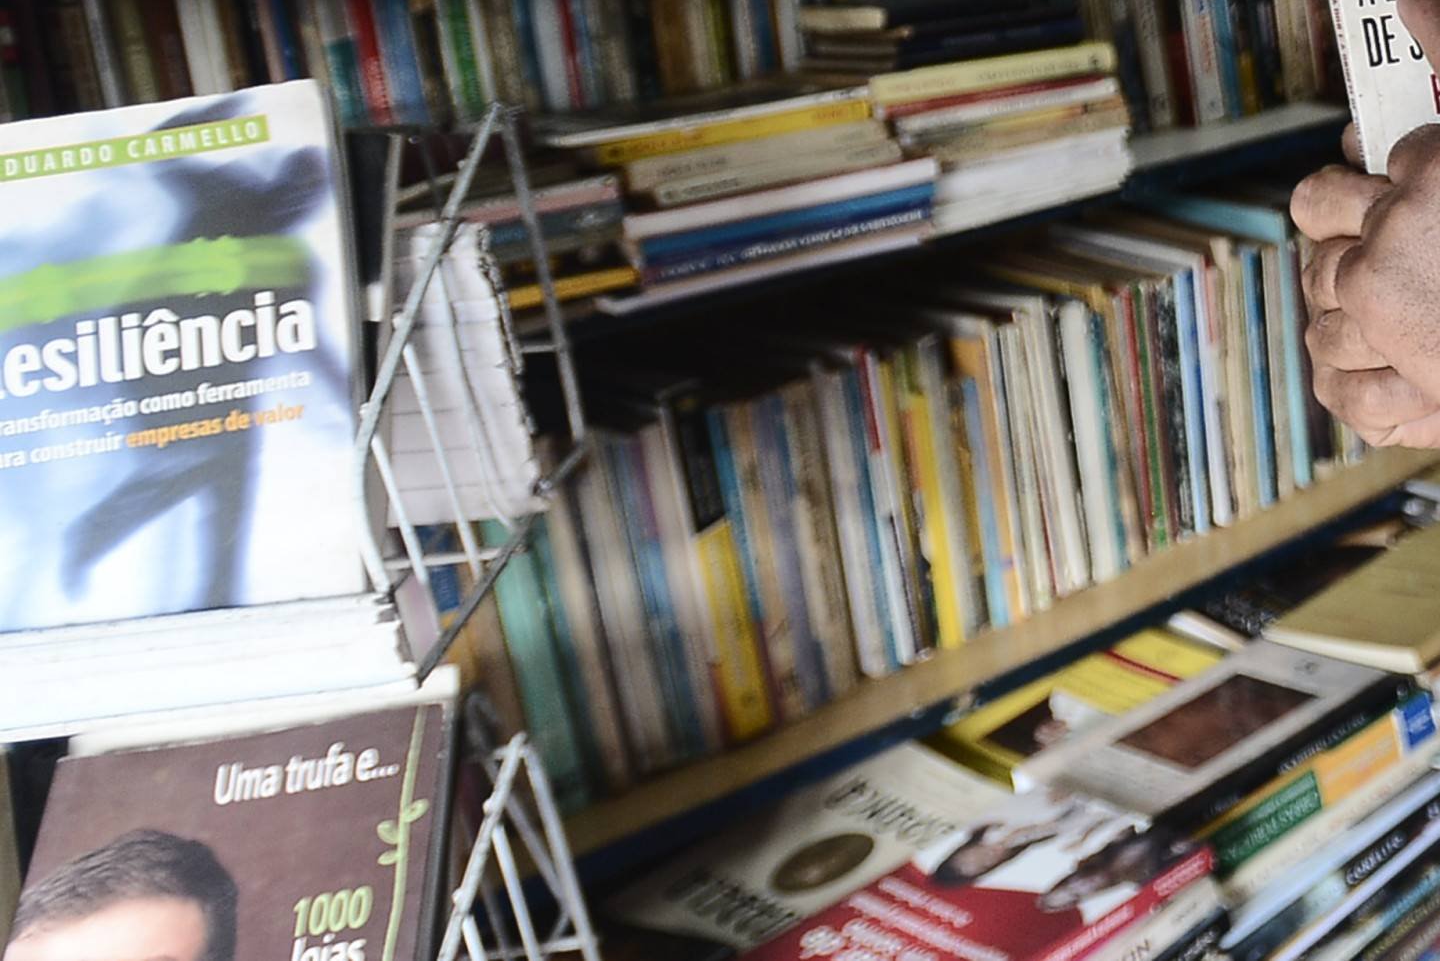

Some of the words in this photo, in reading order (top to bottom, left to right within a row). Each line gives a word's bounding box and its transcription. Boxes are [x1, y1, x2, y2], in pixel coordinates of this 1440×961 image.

[1361, 15, 1401, 68] DE
[4, 144, 113, 176] DUARDO
[127, 120, 261, 158] CARMELLO
[0, 291, 317, 399] esiliência
[0, 397, 138, 437] ransformação
[140, 389, 196, 415] como
[196, 371, 313, 405] ferramenta
[30, 431, 125, 464] construir
[127, 417, 223, 448] empresas
[224, 409, 251, 432] de
[255, 399, 306, 426] valor
[214, 761, 284, 805] Uma
[284, 741, 356, 794] trufa
[356, 748, 400, 782] e...
[293, 885, 374, 938] 1000
